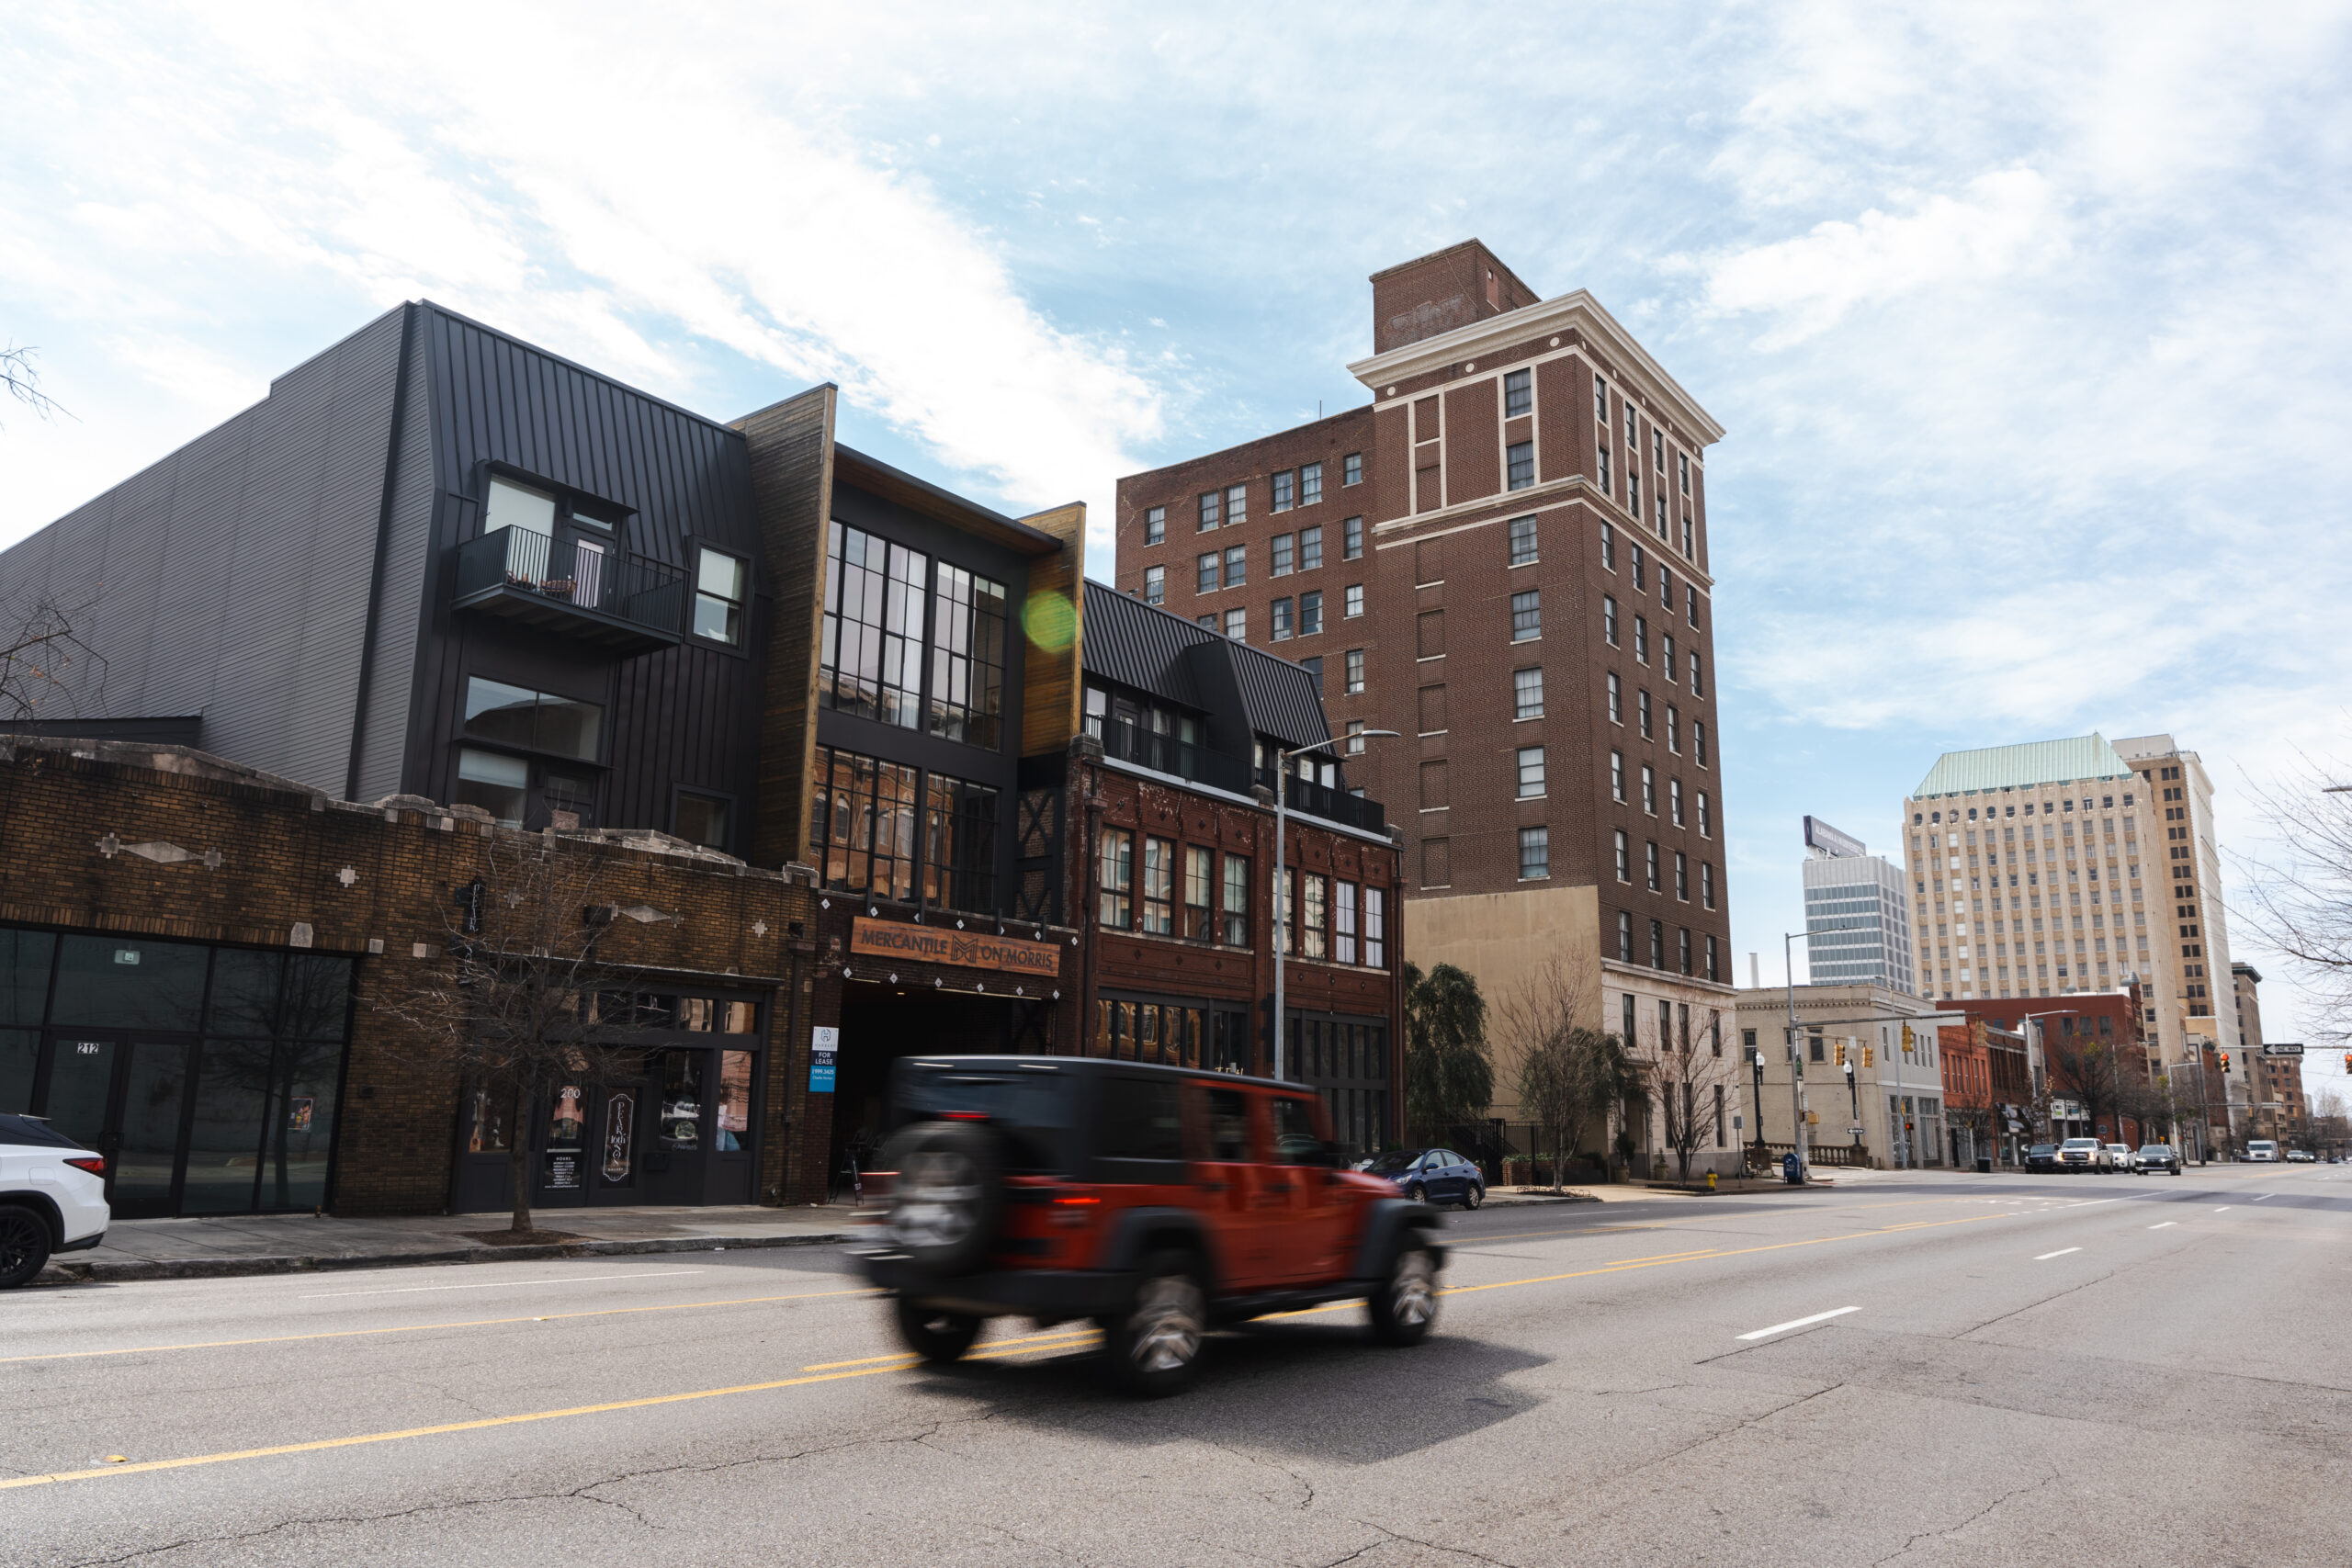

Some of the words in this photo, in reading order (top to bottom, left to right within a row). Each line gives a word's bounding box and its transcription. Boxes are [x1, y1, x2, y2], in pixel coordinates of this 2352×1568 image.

[861, 929, 948, 955] MERCANTILE
[980, 945, 1003, 962] ON
[1005, 948, 1053, 968] MORRIS
[78, 1043, 98, 1054] 212
[560, 1088, 581, 1099] 200
